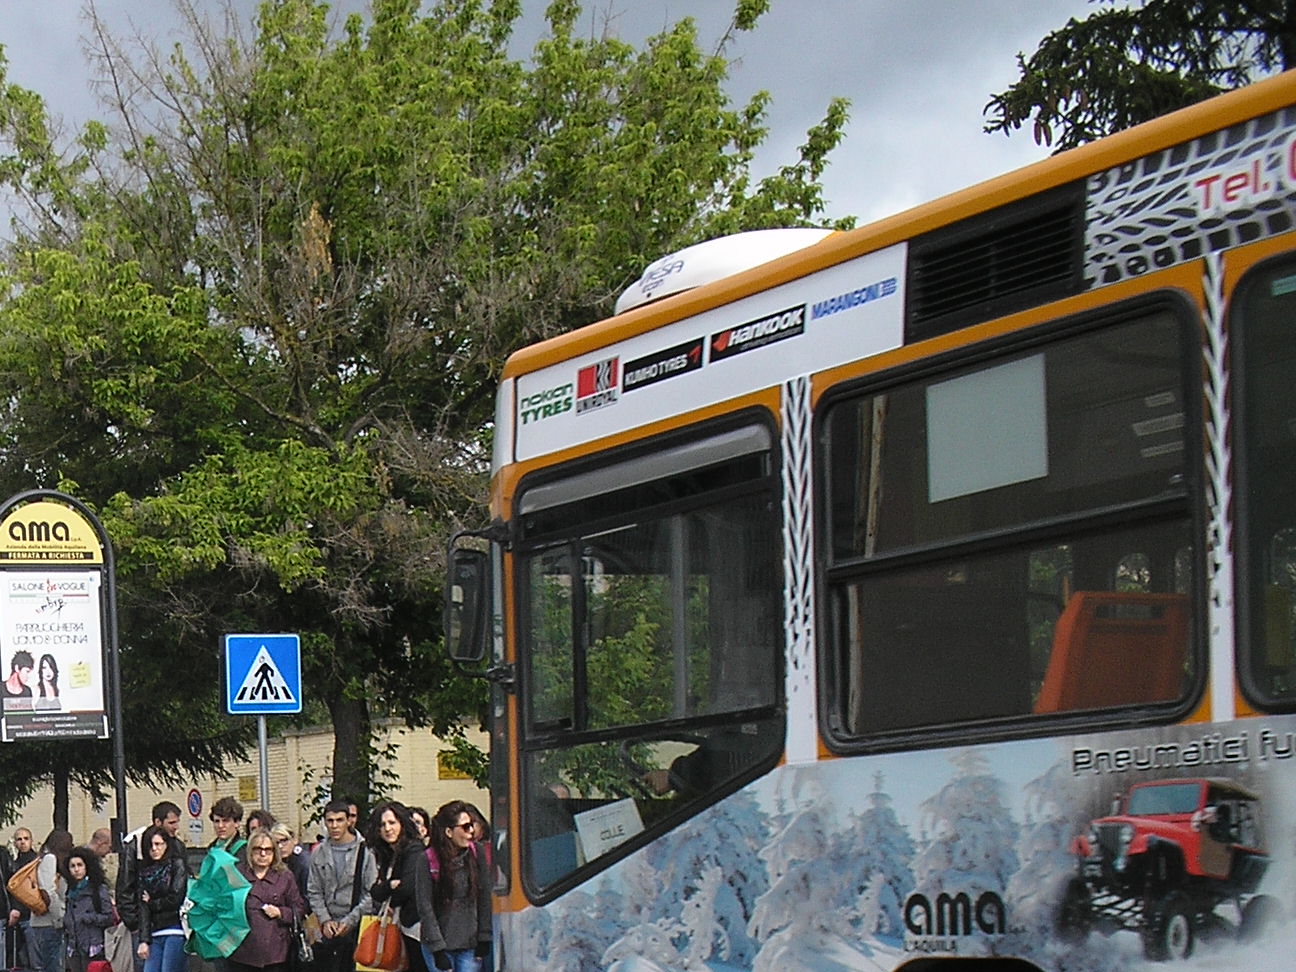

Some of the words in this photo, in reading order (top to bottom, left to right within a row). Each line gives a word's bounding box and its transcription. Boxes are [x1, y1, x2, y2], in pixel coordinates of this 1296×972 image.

[1193, 159, 1271, 211] Tel.
[810, 283, 881, 320] MARANGONI
[624, 370, 658, 387] KUMHO
[657, 354, 689, 374] TYRES
[520, 383, 574, 411] nokian
[521, 397, 573, 425] TYRES
[8, 521, 70, 541] ama
[49, 551, 85, 559] RICHIESTA
[12, 582, 44, 591] SALONE
[58, 582, 86, 591] VOGUE
[1072, 730, 1250, 776] Pneumatici
[1259, 728, 1296, 760] fu
[905, 891, 1006, 936] ama
